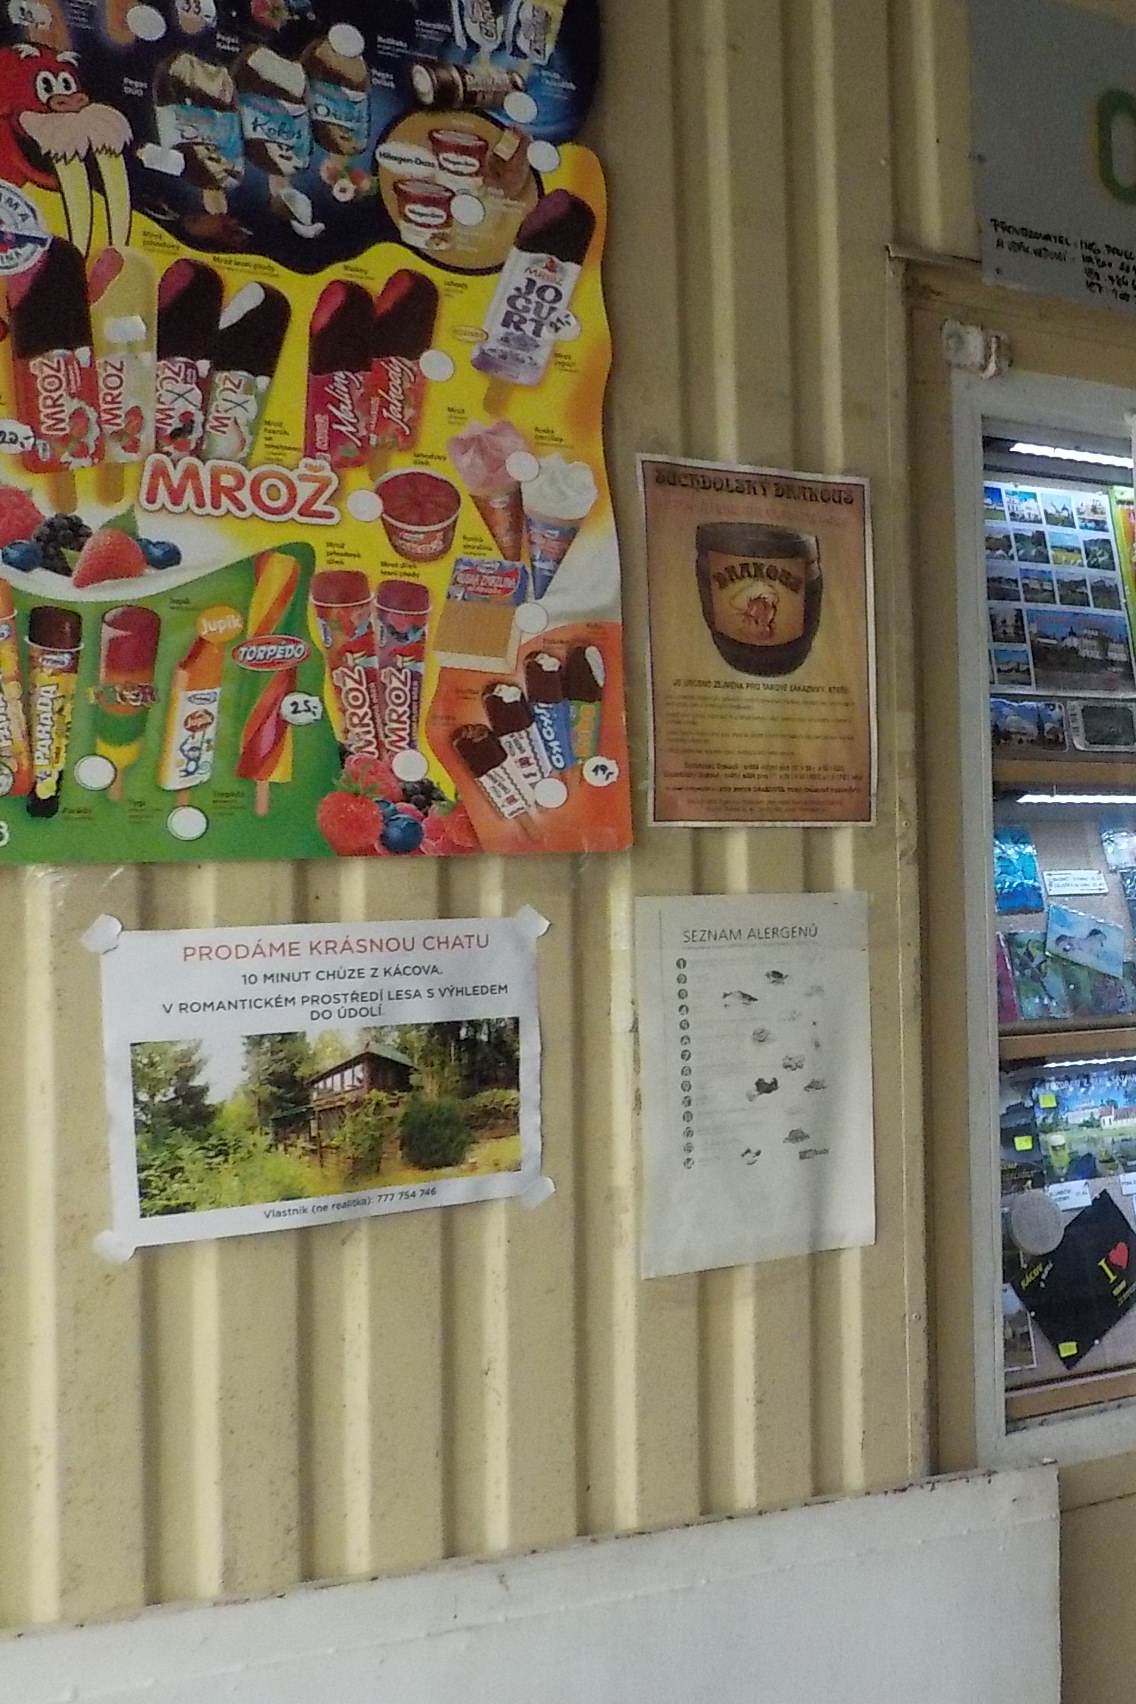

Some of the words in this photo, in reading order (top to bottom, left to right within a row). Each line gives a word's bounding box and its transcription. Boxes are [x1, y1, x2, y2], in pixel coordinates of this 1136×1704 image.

[143, 455, 338, 522] MROŽ
[238, 640, 305, 662] TORPÉDO
[682, 928, 742, 944] SEZNAM
[746, 922, 818, 941] ALERGENŮ
[182, 938, 301, 962] PRODÁME
[309, 935, 416, 957] KRÁSNOU
[422, 933, 490, 951] CHATU
[241, 973, 258, 986] 10
[263, 970, 311, 985] MINUT
[315, 965, 366, 982] CHŮZE
[370, 967, 379, 979] Z
[162, 1003, 173, 1014] V
[178, 995, 296, 1014] ROMANTICKÉM
[300, 987, 384, 1007] PROSTŘEDÍ
[387, 988, 422, 1001] LESA
[426, 987, 434, 998] S
[438, 982, 509, 999] VÝHLEDEM
[310, 1008, 332, 1021] DO
[311, 1201, 328, 1214] (ne
[377, 1193, 394, 1204] 777
[400, 1190, 416, 1200] 754
[419, 1187, 437, 1198] 746
